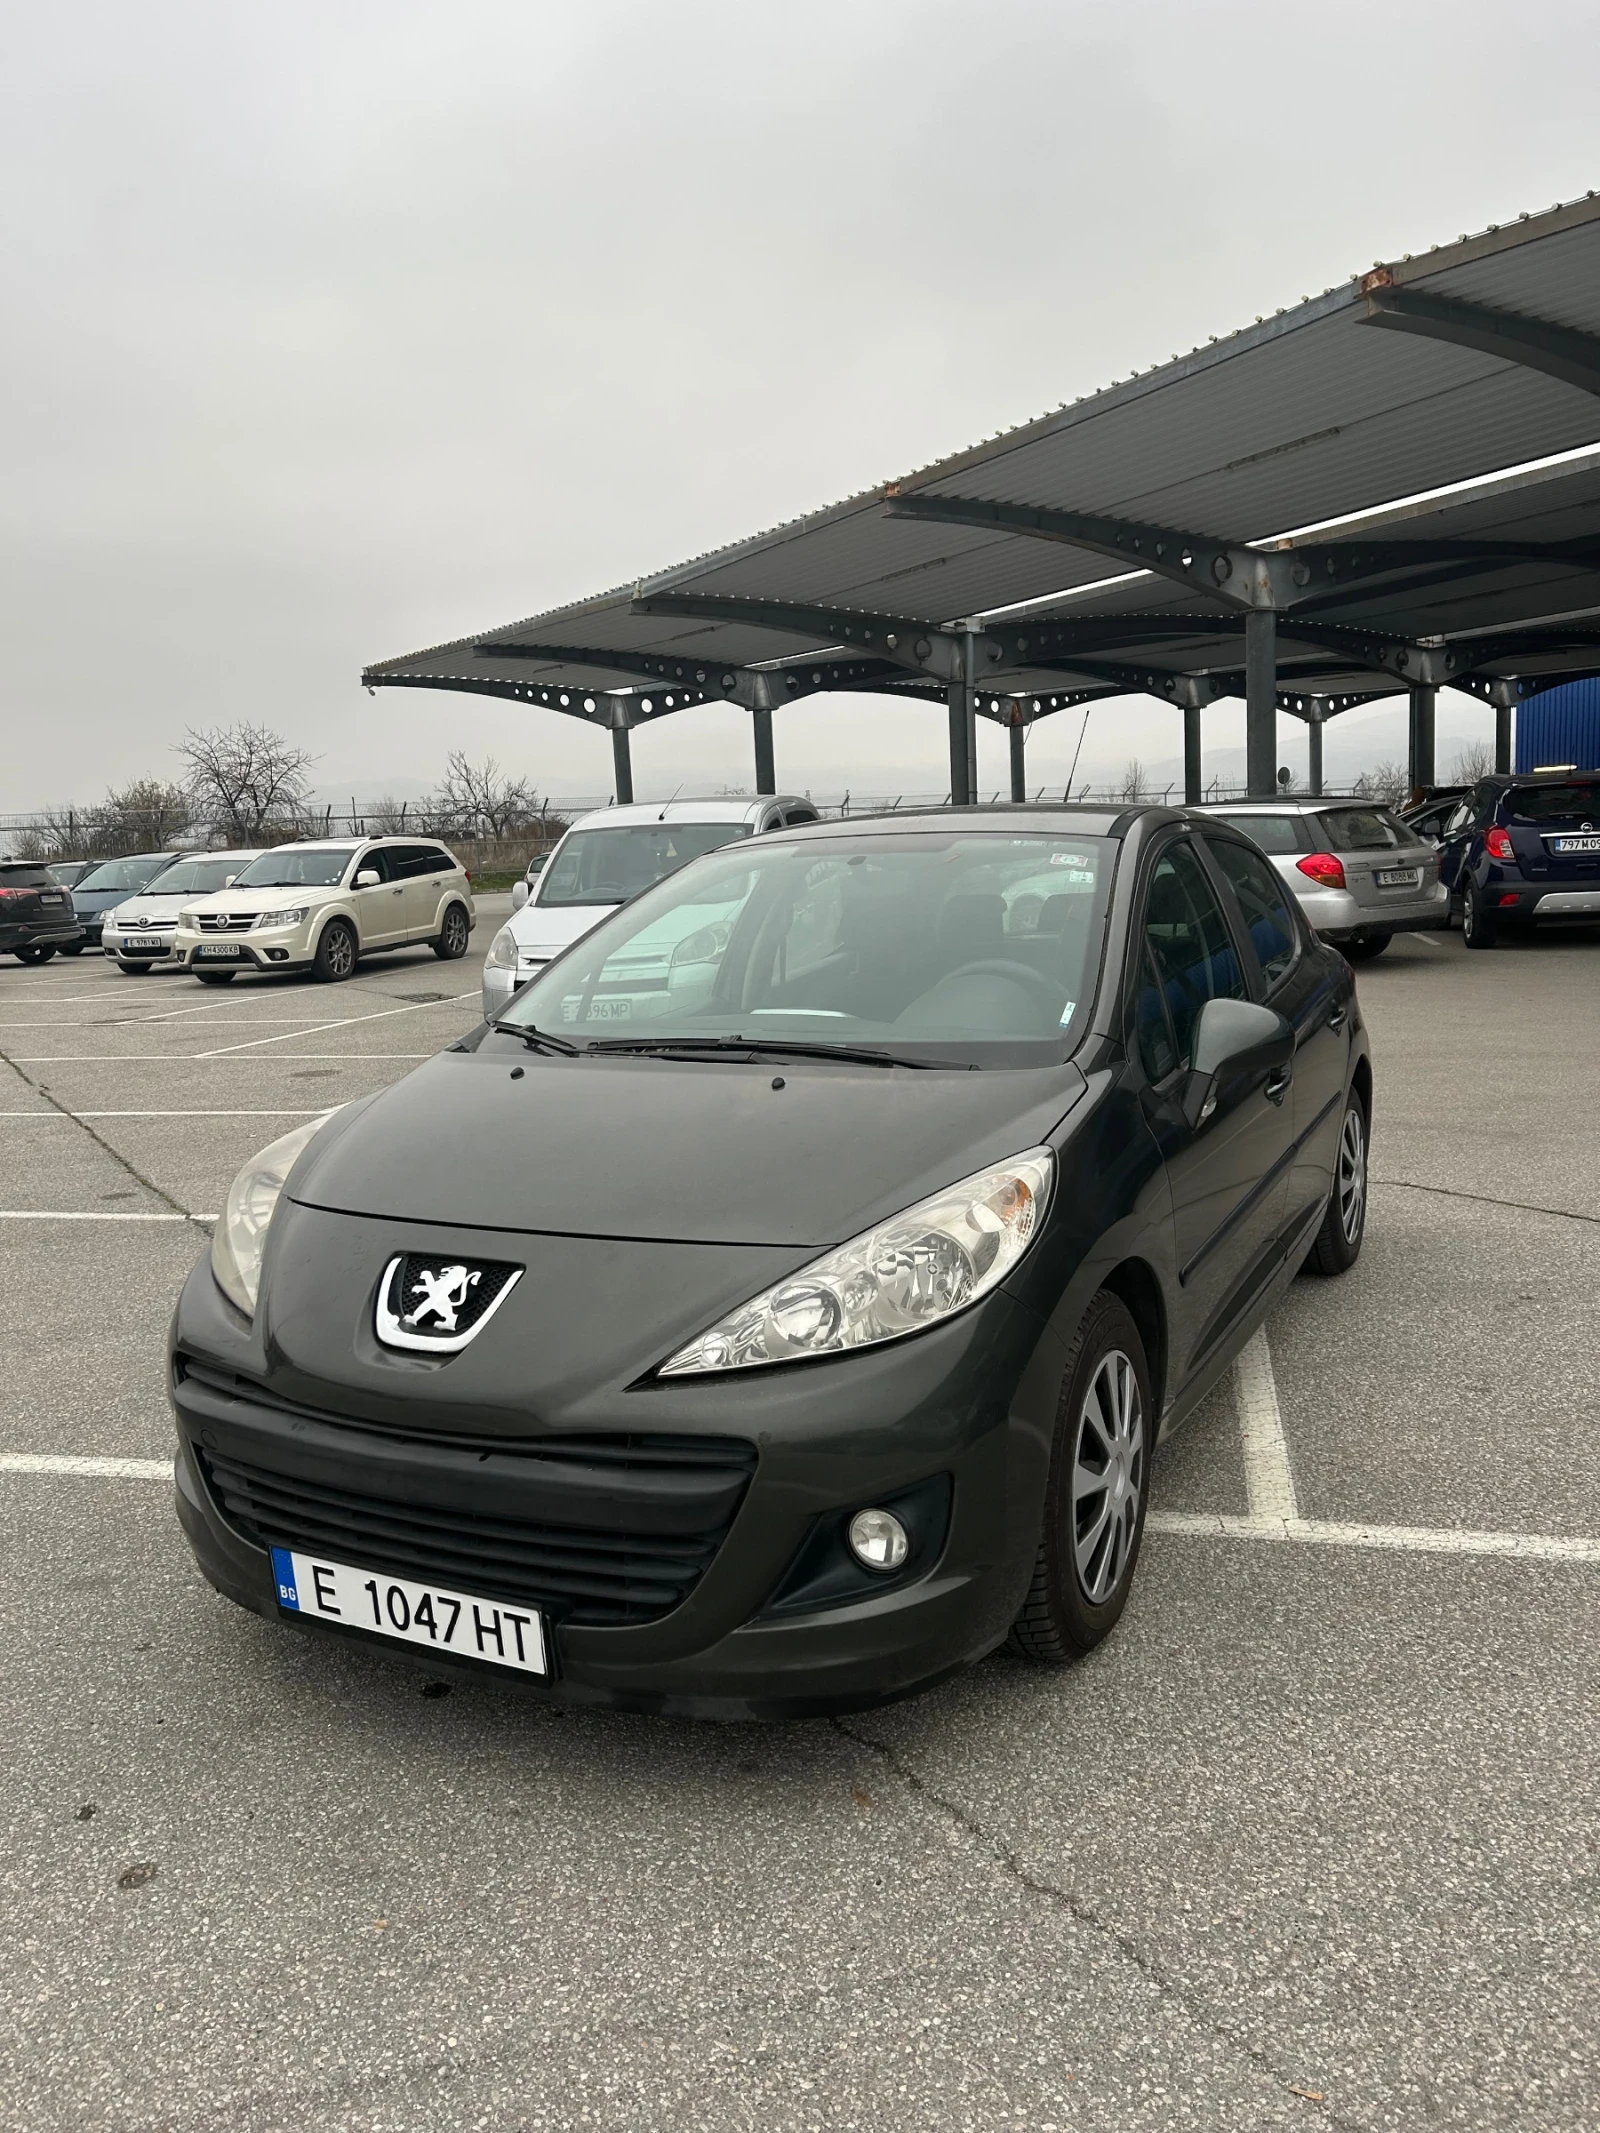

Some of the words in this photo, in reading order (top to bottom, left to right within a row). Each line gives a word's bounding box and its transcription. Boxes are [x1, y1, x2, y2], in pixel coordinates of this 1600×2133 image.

[1383, 873, 1389, 883] E
[130, 939, 135, 947] E
[562, 1005, 570, 1019] E
[279, 1584, 297, 1602] BG
[311, 1564, 341, 1616] E
